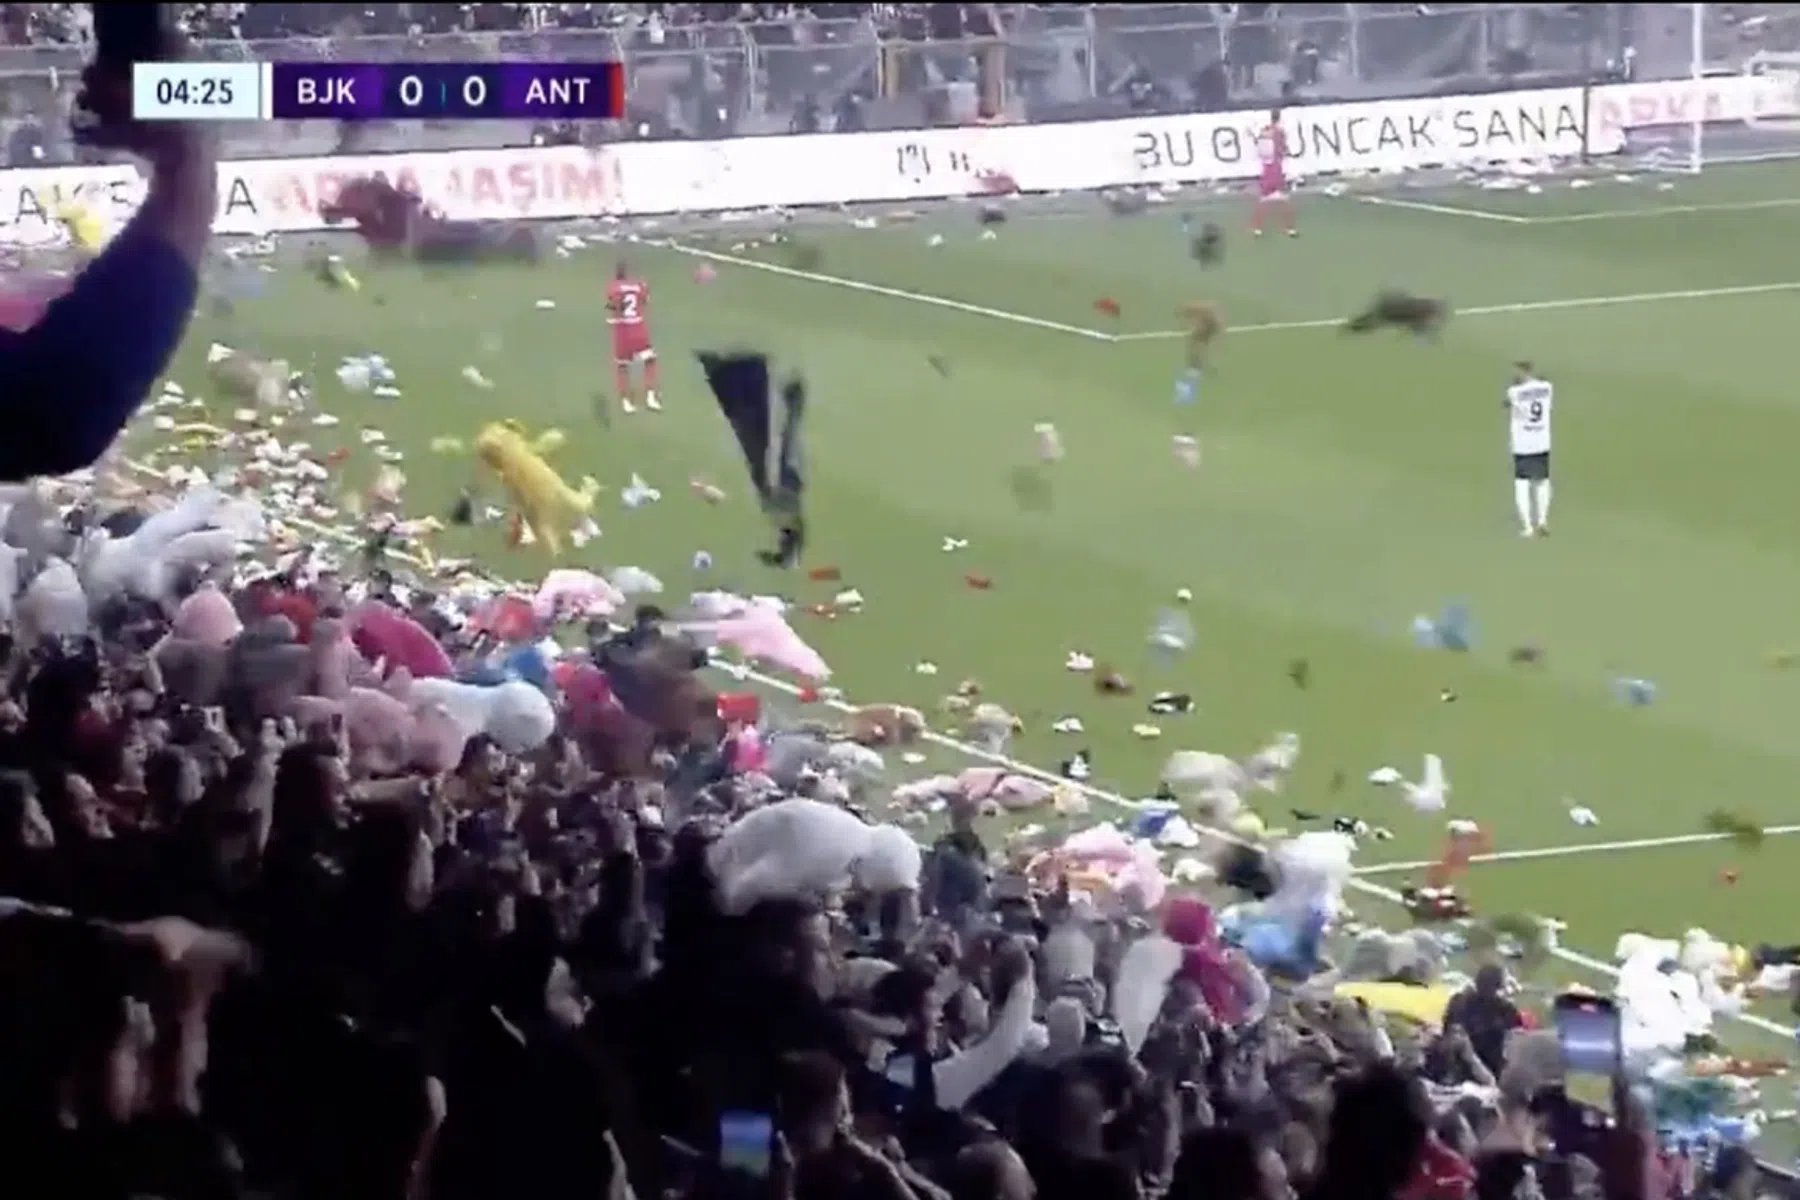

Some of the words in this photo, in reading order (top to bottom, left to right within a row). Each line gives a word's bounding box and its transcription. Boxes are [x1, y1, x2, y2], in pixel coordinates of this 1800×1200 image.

[1211, 114, 1436, 163] OUNCAK
[1452, 105, 1585, 149] SANA
[623, 293, 637, 317] 2
[1529, 401, 1543, 423] 9
